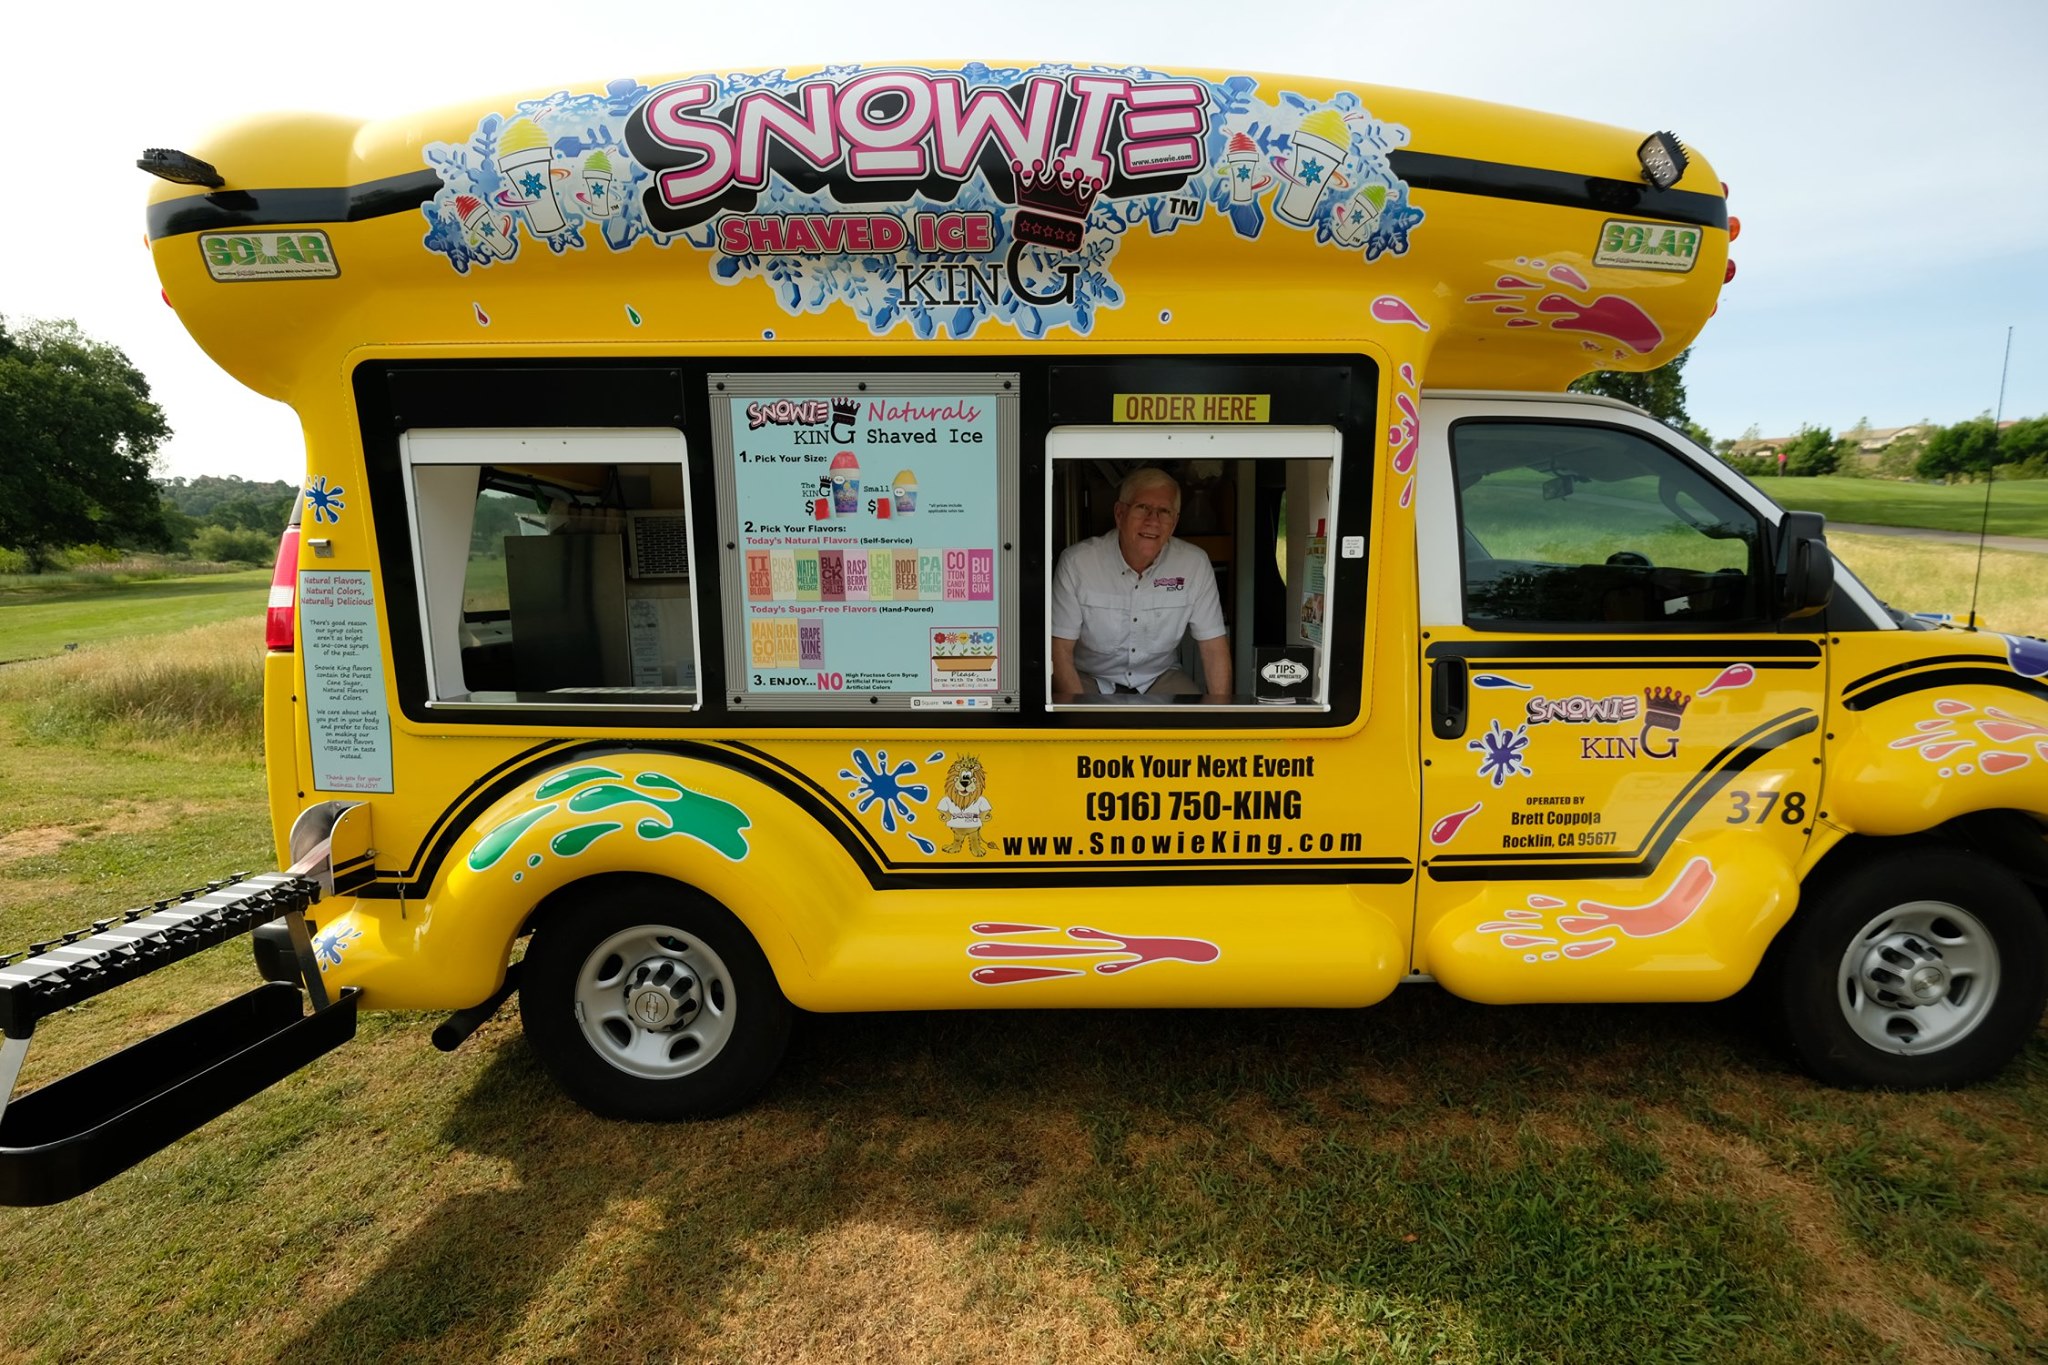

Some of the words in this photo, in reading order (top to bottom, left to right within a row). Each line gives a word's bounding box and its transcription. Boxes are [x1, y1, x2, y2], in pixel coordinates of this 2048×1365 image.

[642, 70, 1207, 208] SNOWIE
[1131, 155, 1192, 167] www.snowie.com
[1169, 197, 1199, 217] TM
[720, 213, 906, 256] SHAVED
[915, 213, 996, 255] ICE
[1602, 224, 1697, 257] SOLAR
[205, 235, 331, 266] SOLAR
[898, 243, 1083, 305] KING
[747, 399, 829, 430] SNOWIE
[867, 400, 982, 422] Naturals
[1126, 396, 1196, 420] ORDER
[1203, 396, 1256, 420] HERE
[794, 421, 856, 445] KING
[866, 428, 938, 444] Shaved
[949, 428, 984, 444] Ice
[739, 451, 752, 462] 1.
[755, 454, 777, 463] Pick
[779, 454, 801, 463] Your
[804, 454, 827, 463] Size:
[802, 486, 831, 498] KING
[744, 521, 757, 533] 2.
[760, 525, 781, 533] Pick
[783, 525, 806, 533] Your
[808, 525, 846, 533] Flavors:
[746, 537, 782, 546] Today's
[860, 537, 913, 545] (Self-Service)
[748, 556, 768, 571] TI
[796, 560, 818, 576] WATER
[821, 557, 843, 570] BLA
[847, 560, 867, 575] RASP
[895, 560, 916, 574] ROOT
[920, 557, 940, 571] PA
[947, 552, 965, 570] CO
[972, 558, 990, 574] BU
[304, 577, 331, 585] Natural
[334, 576, 366, 586] Flavors,
[821, 570, 843, 580] CK
[847, 576, 867, 586] BERRY
[896, 574, 917, 585] BEER
[947, 570, 965, 580] TTON
[972, 574, 990, 583] BBLE
[306, 587, 334, 595] Natural
[336, 587, 365, 596] Colors,
[750, 587, 771, 595] BLOOD
[947, 588, 966, 598] PINK
[972, 584, 990, 593] GUM
[301, 597, 334, 607] Naturally
[337, 597, 374, 606] Delicious!
[750, 606, 786, 615] Today's
[789, 605, 840, 614] Sugar-Free
[752, 622, 774, 639] MAN
[776, 624, 797, 638] BAN
[800, 627, 820, 640] GRAPE
[344, 635, 363, 643] bright
[349, 643, 369, 651] syrups
[752, 640, 775, 656] GO
[777, 639, 797, 654] ANA
[801, 640, 821, 654] VINE
[337, 664, 351, 673] King
[1275, 664, 1296, 674] TIPS
[753, 674, 766, 686] 3.
[769, 677, 816, 686] ENJOY...
[817, 672, 844, 691] NO
[1527, 696, 1639, 725] SNOWIE
[333, 724, 352, 732] prefer
[348, 717, 363, 725] your
[364, 717, 380, 725] body
[1581, 726, 1680, 759] KING
[1076, 755, 1135, 778] Book
[1139, 755, 1192, 778] Your
[1196, 754, 1248, 778] Next
[1253, 754, 1315, 778] Event
[1086, 791, 1160, 821] (916)
[1168, 790, 1302, 821] 750-KING
[1526, 796, 1571, 805] OPERATED
[1572, 796, 1585, 805] BY
[1726, 791, 1806, 825] 378
[1511, 811, 1544, 825] Brett
[1546, 811, 1601, 826] Coppola
[1002, 831, 1363, 857] www.SnowieKing.com
[1502, 834, 1555, 848] Rocklin,
[1558, 833, 1575, 847] CA
[1577, 832, 1616, 846] 95677
